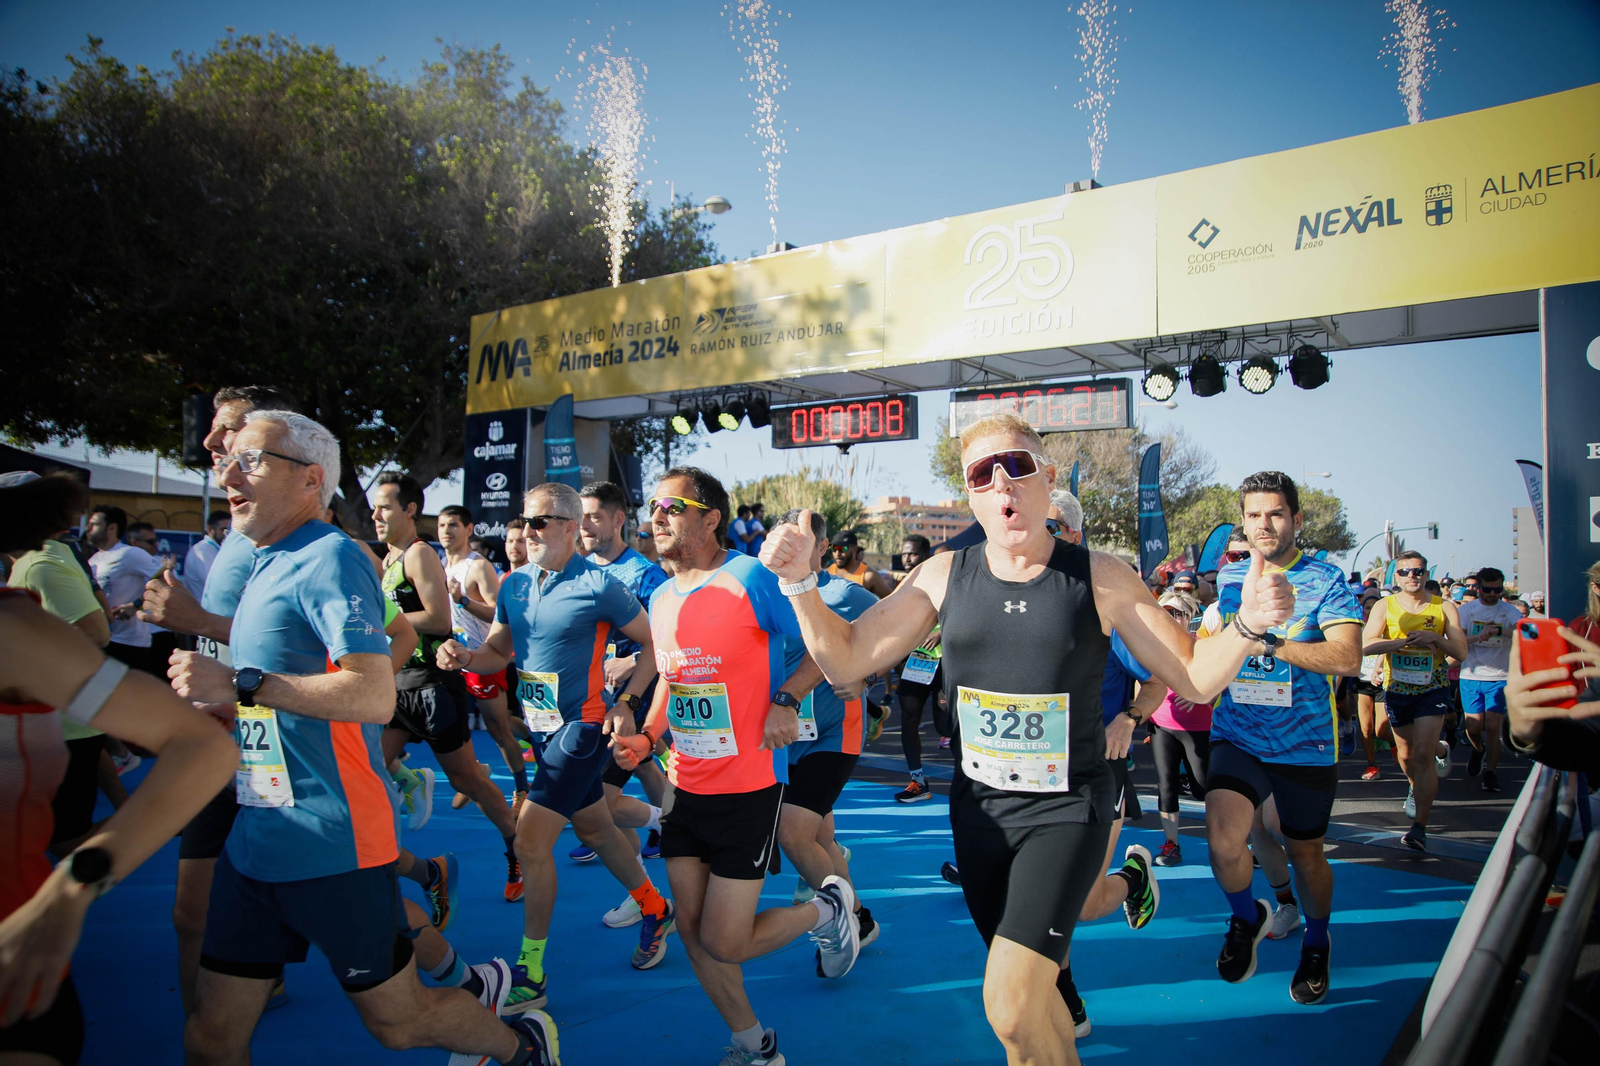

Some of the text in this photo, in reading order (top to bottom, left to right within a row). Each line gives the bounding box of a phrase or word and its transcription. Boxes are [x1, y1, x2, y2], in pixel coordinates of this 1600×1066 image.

[1480, 153, 1600, 198] ALMERÍ
[1480, 193, 1547, 214] CIUDAD
[1187, 243, 1273, 265] COOPERACIÓN
[1303, 240, 1324, 250] 2020
[964, 212, 1075, 311] 25
[1187, 262, 1216, 276] 2005
[559, 314, 680, 348] Medio Maratón
[966, 303, 1074, 340] EDICIÓN
[690, 321, 844, 354] RAMÓN RUIZ ANDÚJAR
[558, 335, 680, 372] Almería 2024
[474, 441, 518, 461] cajamar
[481, 491, 511, 500] HYUNDAI
[674, 646, 702, 658] MEDIO
[676, 655, 722, 668] MARATÓN
[1396, 655, 1429, 667] 1064
[681, 665, 718, 676] ALMERÍA
[912, 658, 935, 670] 1773
[1241, 671, 1266, 679] PEPILLO
[675, 696, 713, 720] 910
[979, 709, 1045, 741] 328
[973, 735, 994, 747] JOSE
[994, 740, 1051, 750] CARRETERO
